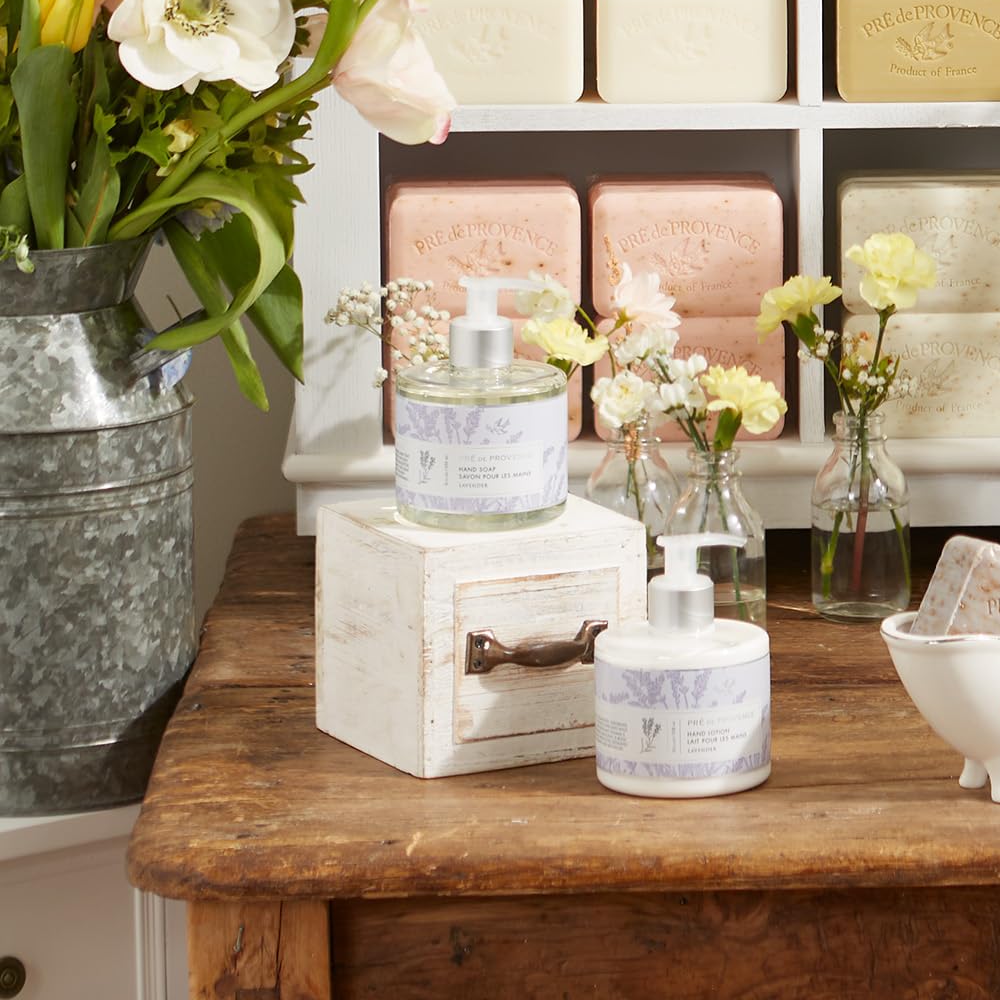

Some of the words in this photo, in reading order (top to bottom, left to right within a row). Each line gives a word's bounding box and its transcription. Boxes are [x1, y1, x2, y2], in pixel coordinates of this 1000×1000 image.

[863, 13, 896, 36] PRÉ
[897, 5, 913, 22] de
[891, 62, 927, 75] Product
[931, 64, 942, 75] of
[946, 64, 976, 74] France
[449, 224, 465, 241] de
[467, 223, 558, 258] PROVENCE
[653, 222, 668, 239] de
[670, 221, 761, 256] PROVENCE
